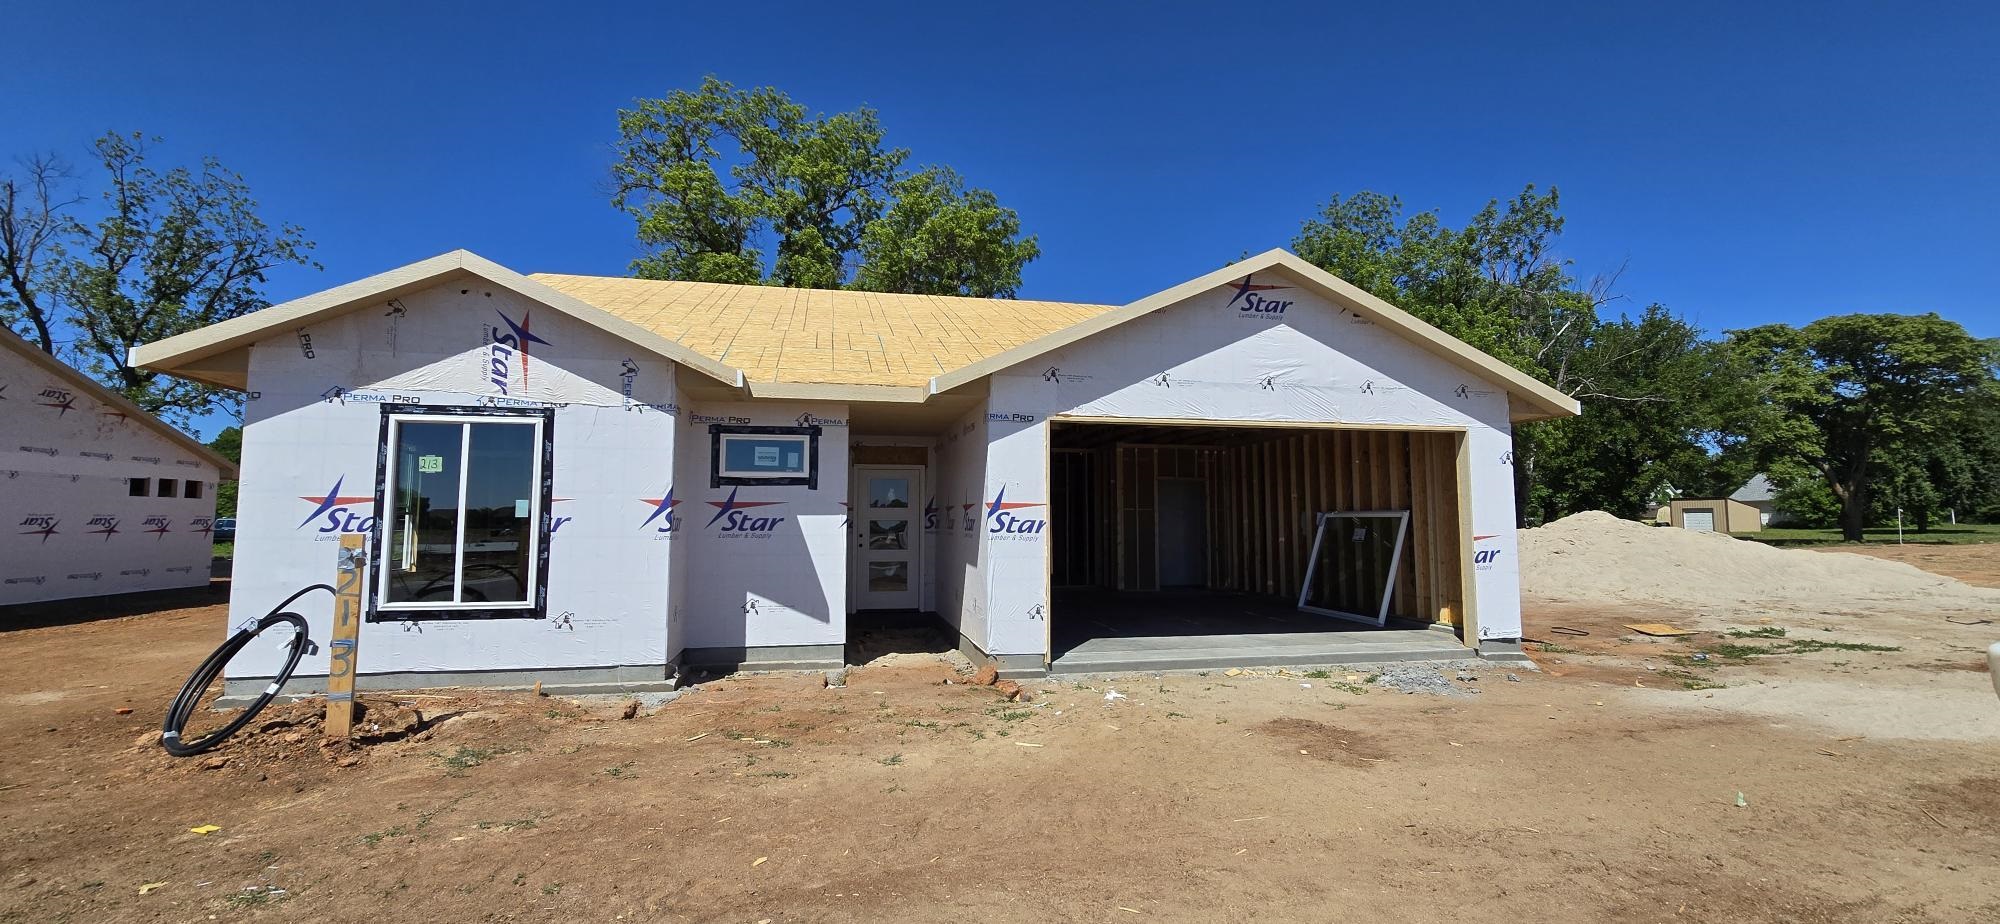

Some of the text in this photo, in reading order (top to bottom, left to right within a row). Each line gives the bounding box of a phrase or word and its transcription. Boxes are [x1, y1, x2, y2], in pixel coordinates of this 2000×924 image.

[1241, 293, 1293, 313] Star
[482, 323, 490, 349] Lumber
[300, 334, 315, 359] PRO
[491, 326, 518, 395] Star
[480, 358, 490, 381] Supply
[38, 389, 70, 403] Star
[343, 393, 421, 404] PERMA PRO
[497, 398, 538, 406] PERMA
[692, 414, 750, 424] PERMA PRO
[811, 417, 843, 425] PERMA
[1012, 413, 1034, 422] PRO
[420, 458, 438, 469] 213
[20, 517, 53, 530] Star
[86, 517, 115, 529] Star
[142, 517, 167, 529] Star
[191, 518, 211, 528] Star
[319, 507, 373, 533] Sta
[721, 510, 784, 531] Star
[990, 511, 1047, 533] Star
[314, 534, 341, 542] Lumbe
[1475, 550, 1501, 563] ar
